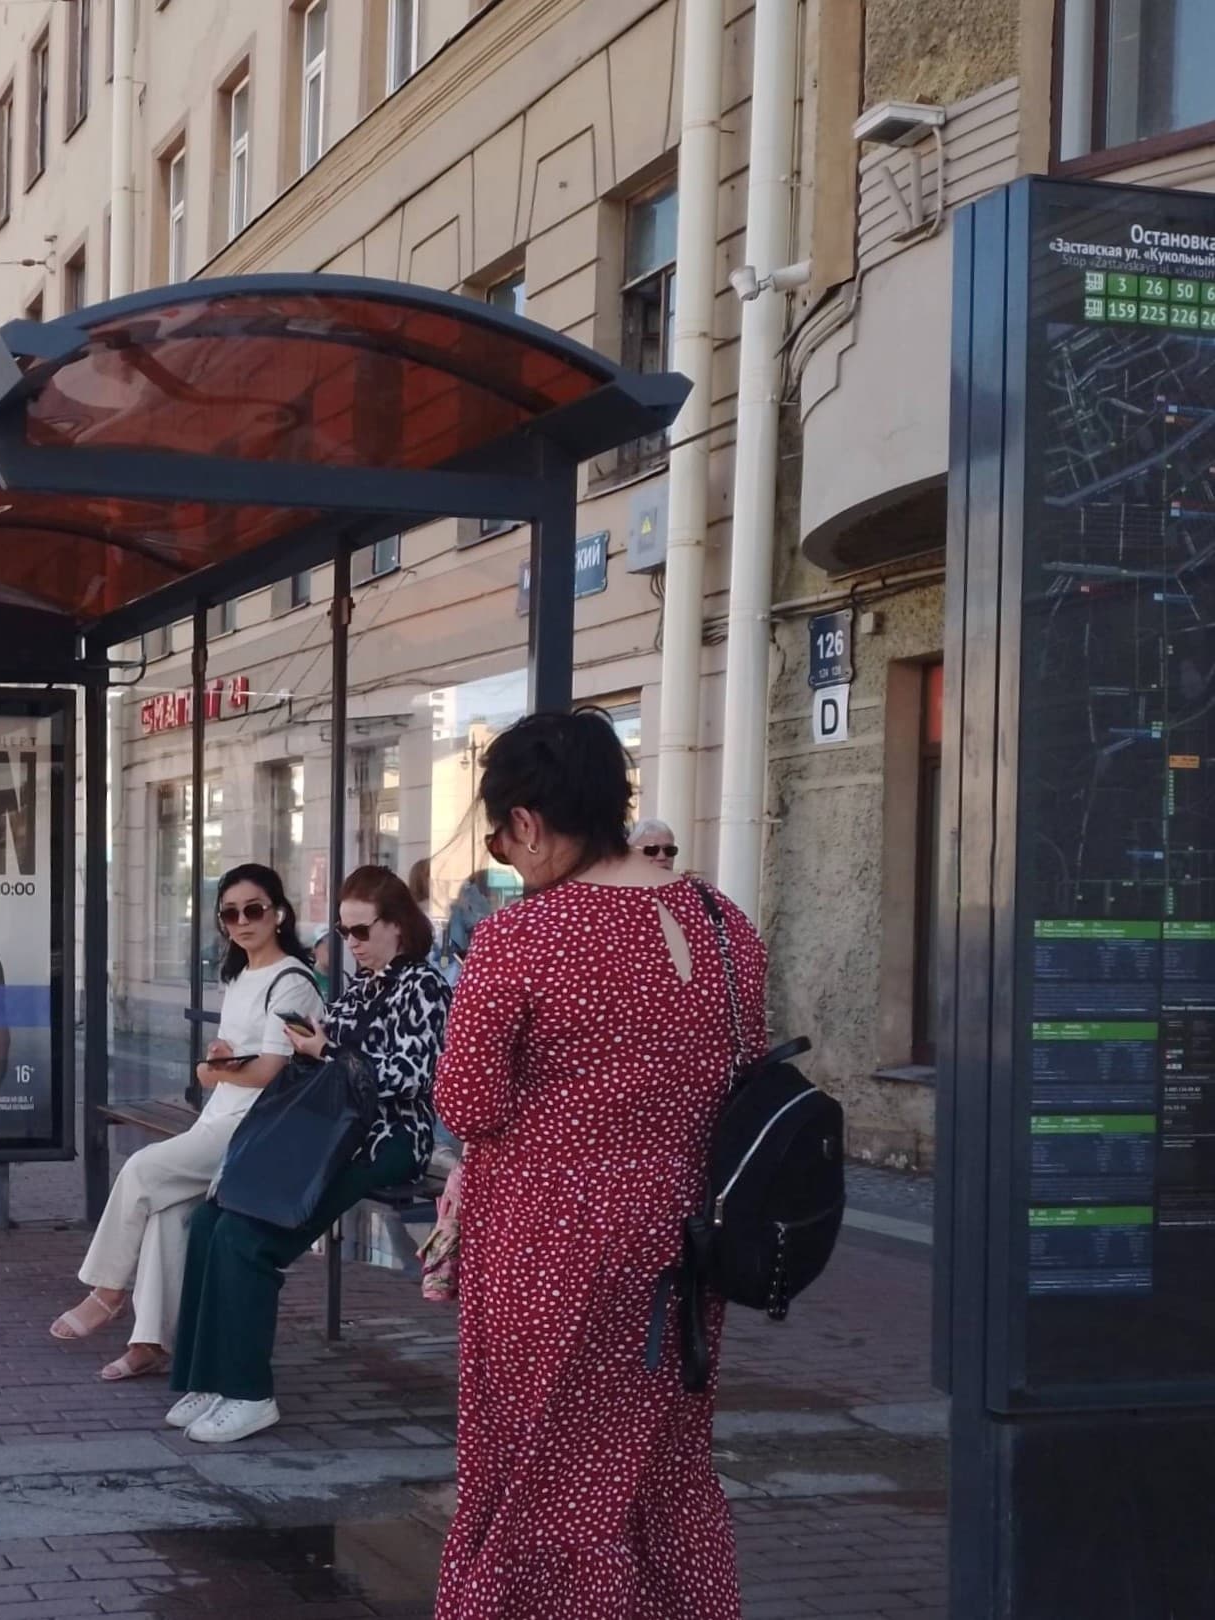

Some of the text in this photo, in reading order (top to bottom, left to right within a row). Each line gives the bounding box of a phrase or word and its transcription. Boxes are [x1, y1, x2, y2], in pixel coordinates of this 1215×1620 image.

[1061, 254, 1086, 268] Stop
[1125, 247, 1142, 262] ул.
[1118, 278, 1127, 293] 3
[1145, 280, 1163, 296] 26
[1176, 283, 1194, 298] 50
[1108, 302, 1136, 319] 159
[1140, 305, 1166, 322] 225
[1171, 308, 1198, 325] 226
[816, 630, 844, 660] 126
[821, 698, 839, 736] D
[14, 1064, 35, 1083] 16+
